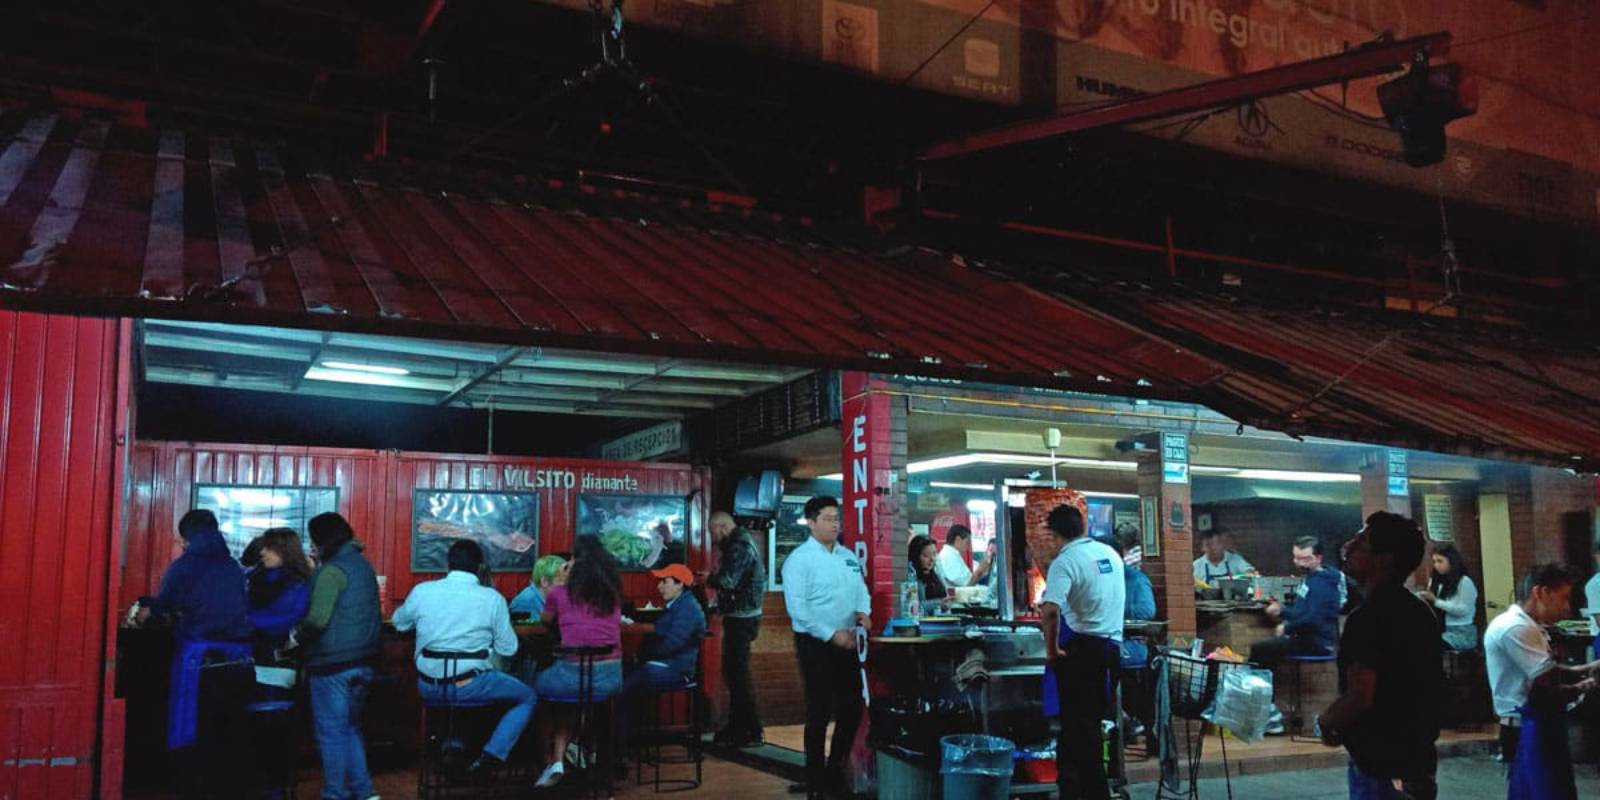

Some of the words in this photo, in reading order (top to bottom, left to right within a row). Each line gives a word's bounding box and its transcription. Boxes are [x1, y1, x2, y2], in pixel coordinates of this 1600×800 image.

[1170, 0, 1285, 50] integral
[469, 467, 492, 490] EL
[504, 468, 576, 489] VILSITO
[581, 473, 638, 492] diamante
